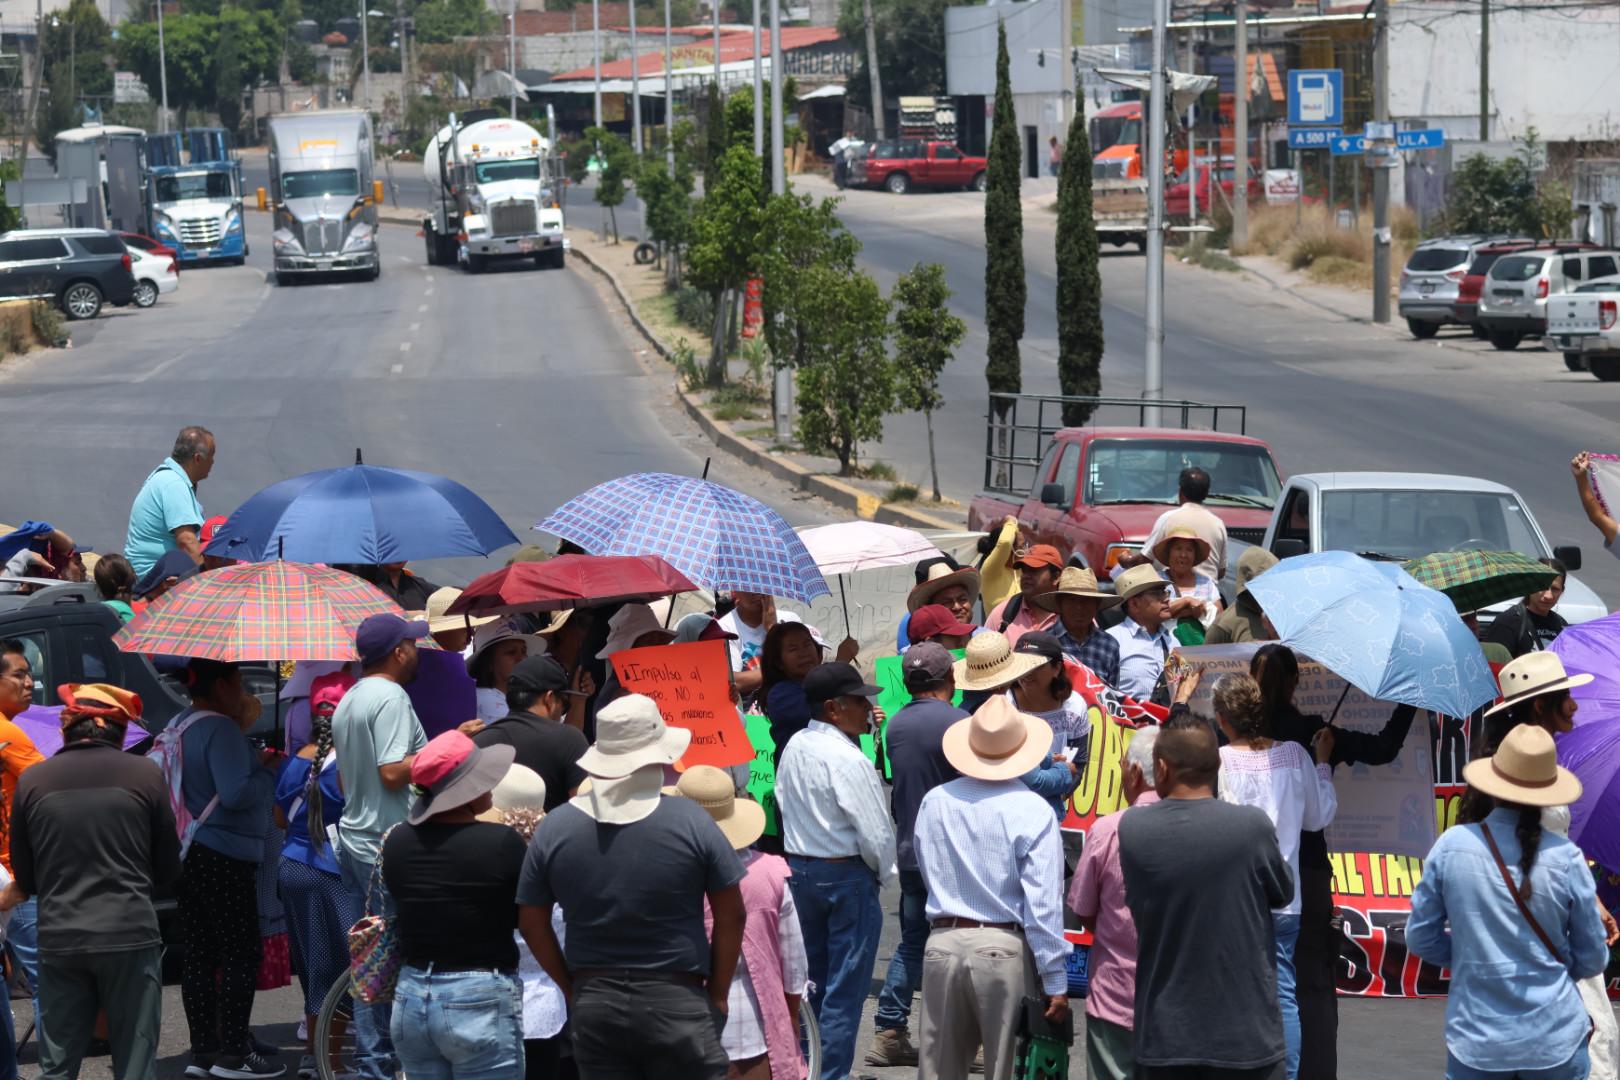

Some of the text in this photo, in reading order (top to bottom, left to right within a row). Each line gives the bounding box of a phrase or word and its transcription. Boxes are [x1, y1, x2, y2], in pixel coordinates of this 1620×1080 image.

[1295, 134, 1305, 144] A
[1306, 133, 1324, 143] 500
[690, 666, 703, 683] al
[674, 686, 691, 702] NO
[749, 770, 774, 786] que
